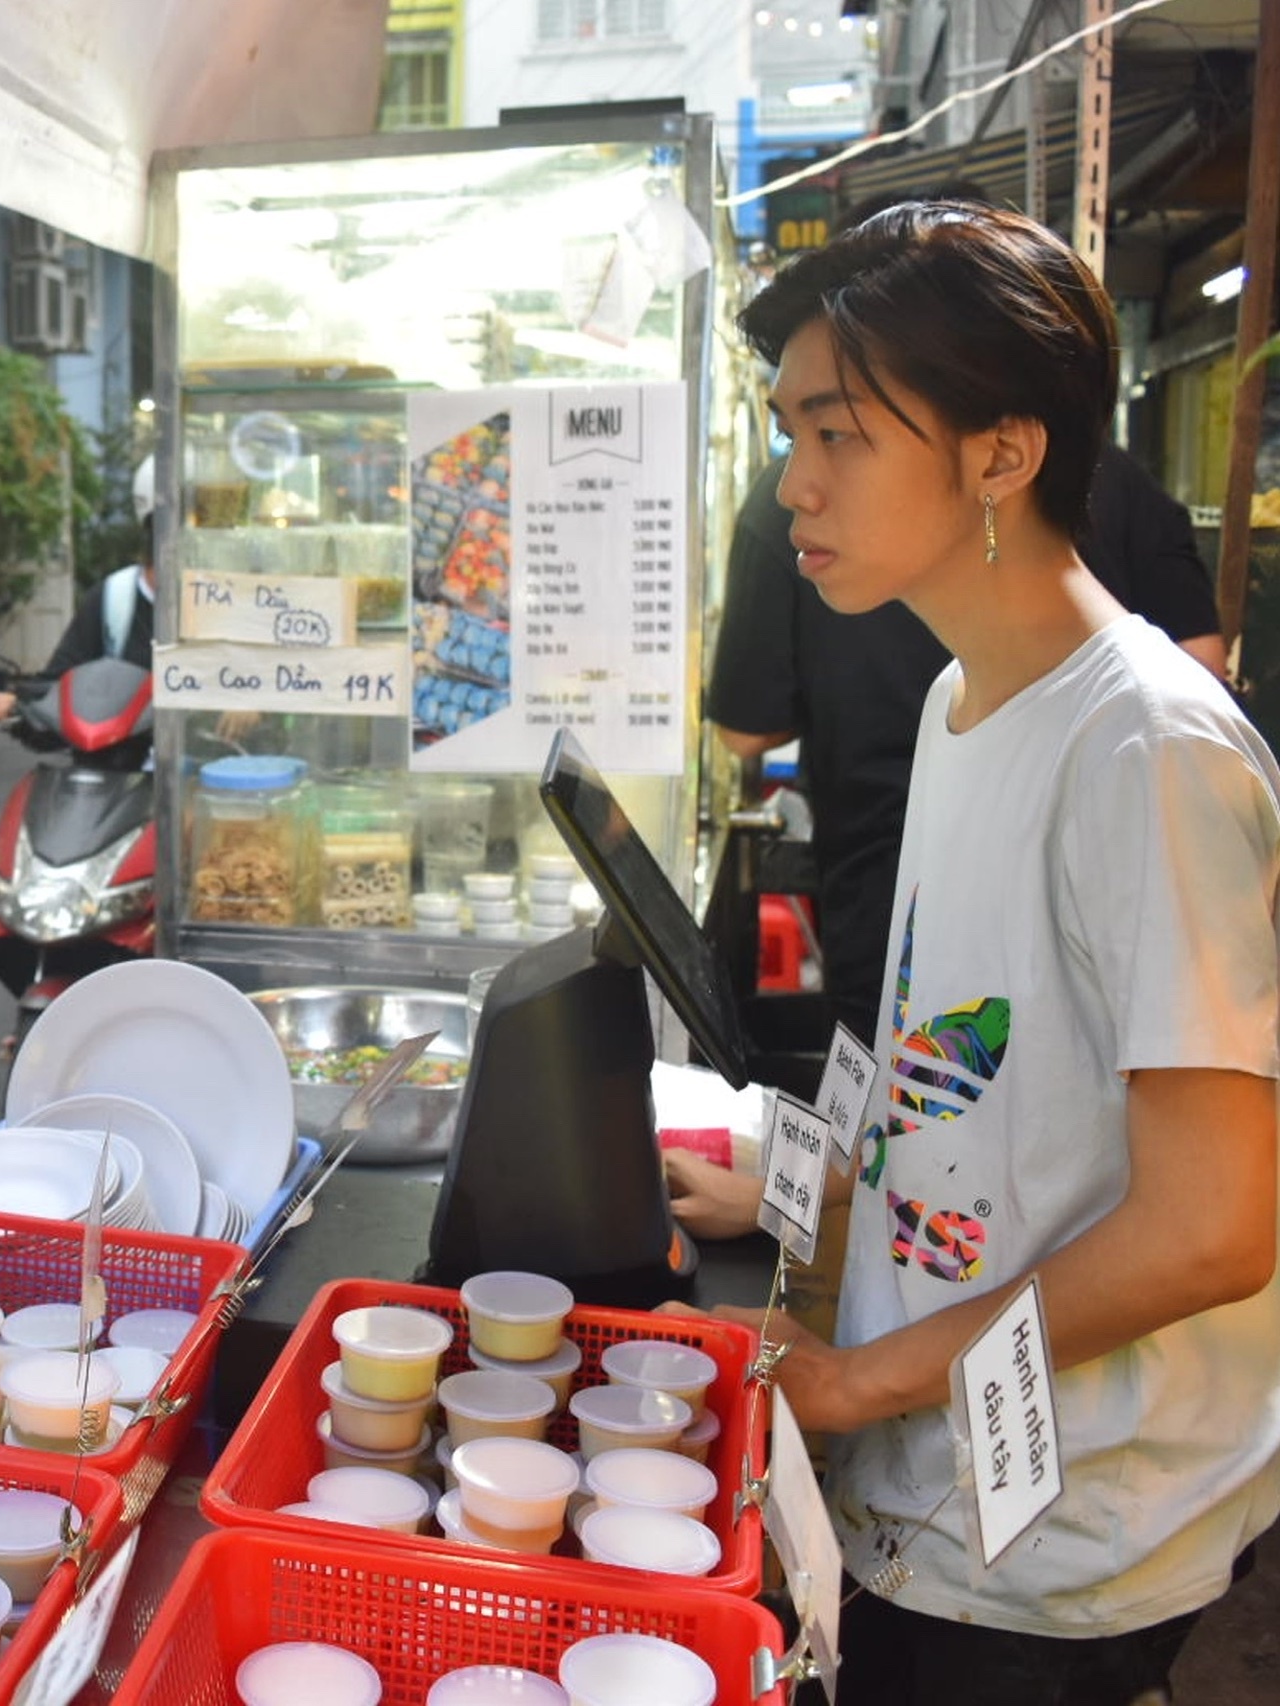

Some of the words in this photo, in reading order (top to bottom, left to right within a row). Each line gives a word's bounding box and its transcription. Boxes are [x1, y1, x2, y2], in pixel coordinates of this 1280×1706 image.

[567, 407, 622, 438] MENU
[164, 665, 201, 692] Ca
[219, 666, 262, 691] Cao
[781, 1114, 800, 1146] Hạnh
[799, 1124, 821, 1156] nhân
[774, 1169, 796, 1202] chanh
[795, 1182, 811, 1217] dây
[1012, 1318, 1038, 1403] Hạnh
[984, 1380, 1005, 1438] dâu
[990, 1437, 1012, 1493] tây
[1023, 1406, 1048, 1487] nhân
